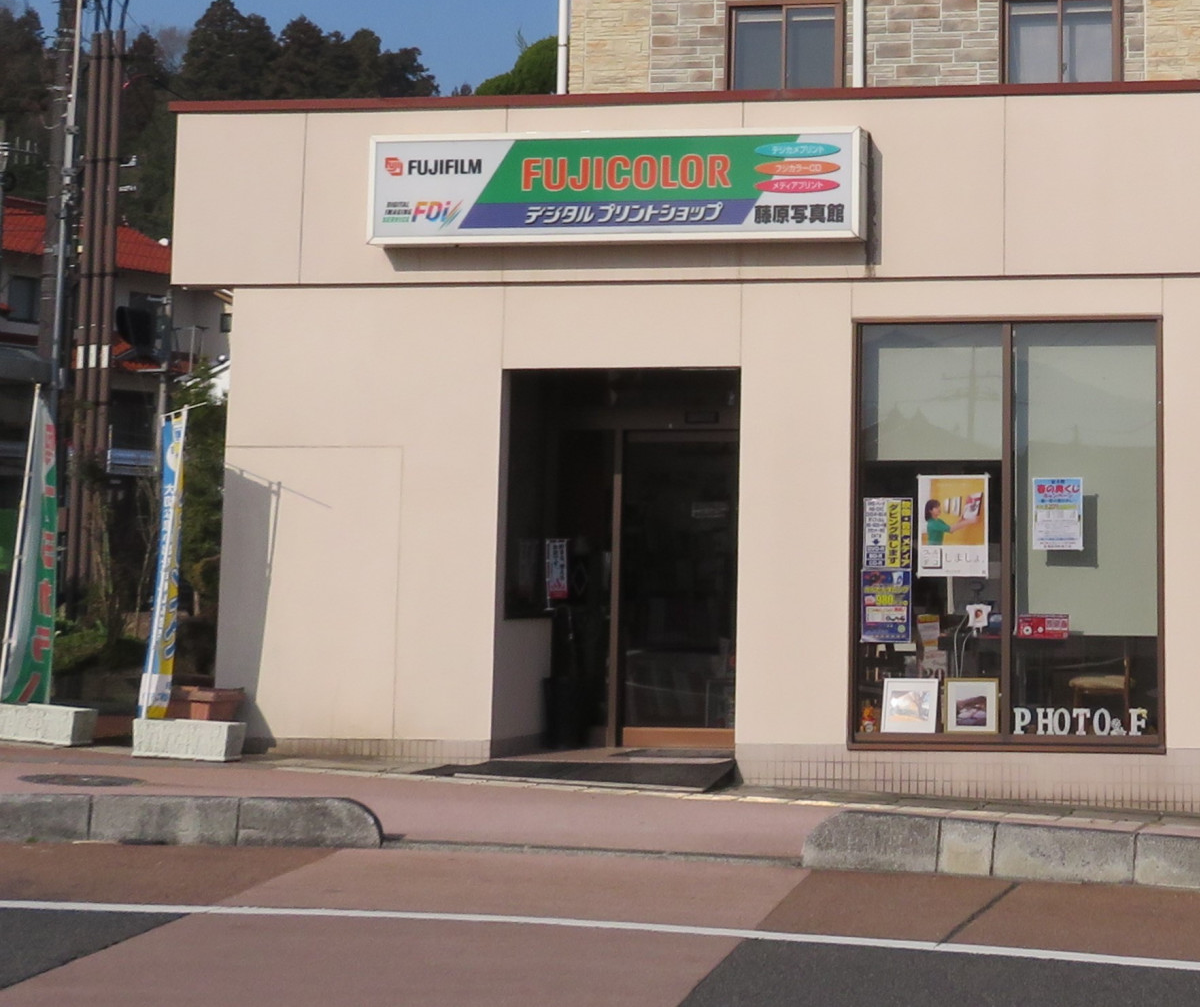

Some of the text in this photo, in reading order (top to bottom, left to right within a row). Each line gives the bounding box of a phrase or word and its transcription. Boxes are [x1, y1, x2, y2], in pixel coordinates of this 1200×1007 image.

[407, 158, 483, 175] FUJIFILM
[521, 153, 732, 192] FUJICOLOR
[772, 180, 824, 190] メディアプリント
[754, 203, 845, 224] 藤原写真館
[1013, 707, 1111, 735] PHOTO
